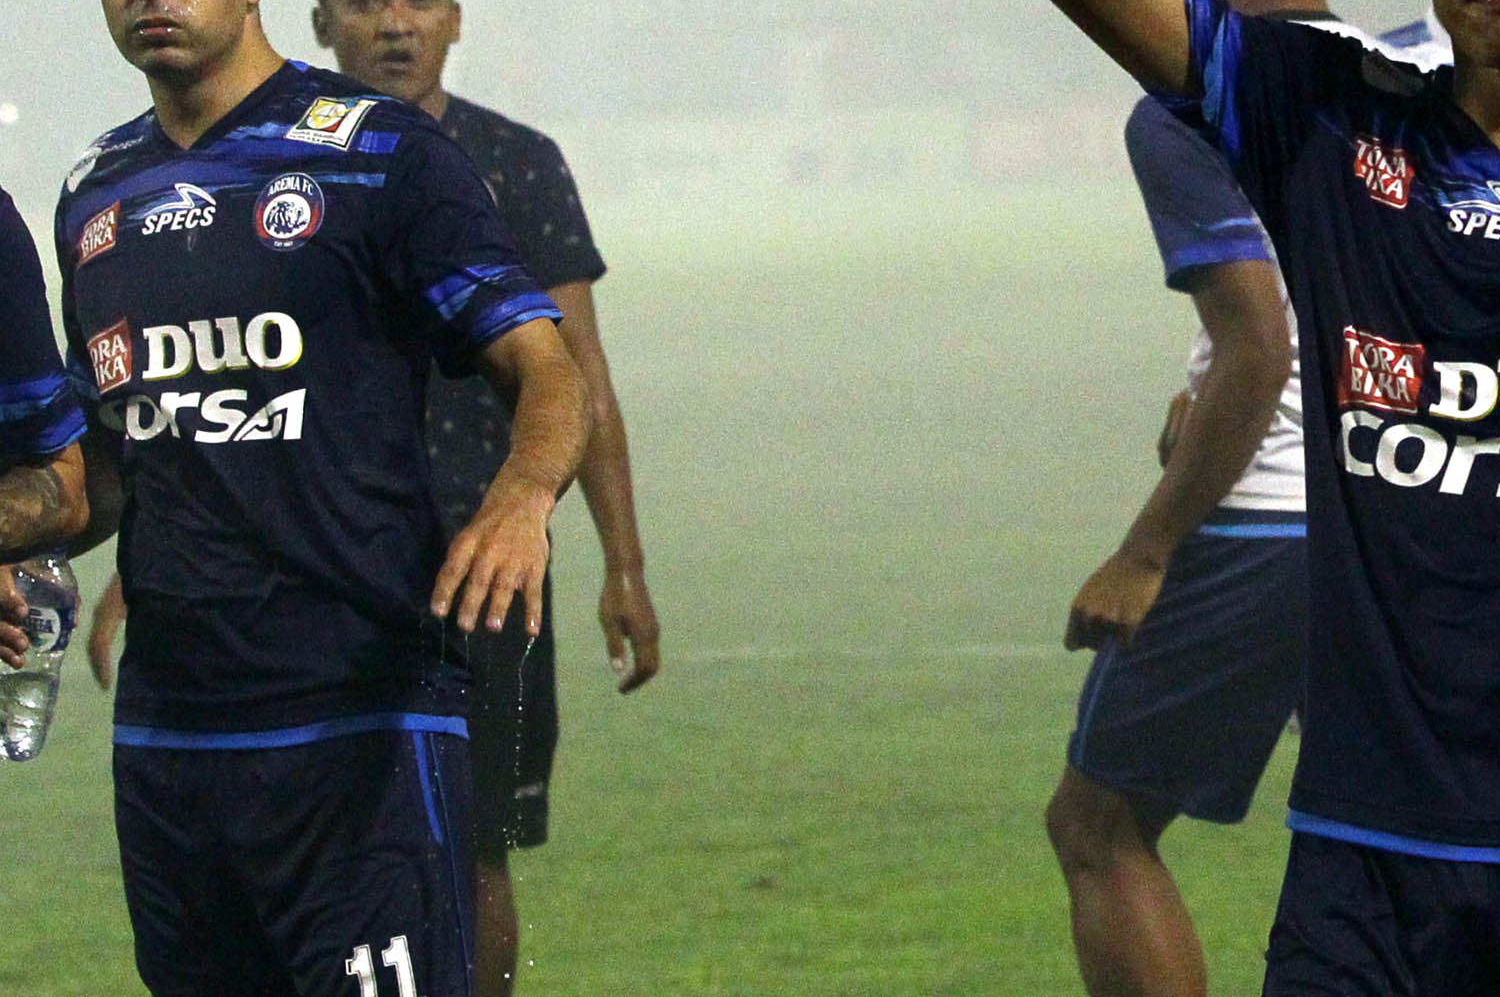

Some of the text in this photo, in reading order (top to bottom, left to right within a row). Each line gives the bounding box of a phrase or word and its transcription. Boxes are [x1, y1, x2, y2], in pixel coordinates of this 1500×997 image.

[267, 175, 314, 197] AREMA FC
[1361, 164, 1404, 200] IKA
[141, 205, 217, 236] SPECS
[90, 333, 128, 366] ORA
[142, 312, 303, 381] DUO
[1345, 338, 1415, 379] TORA
[95, 355, 128, 387] IKA
[1351, 366, 1412, 402] BIKA
[345, 935, 418, 997] 11
